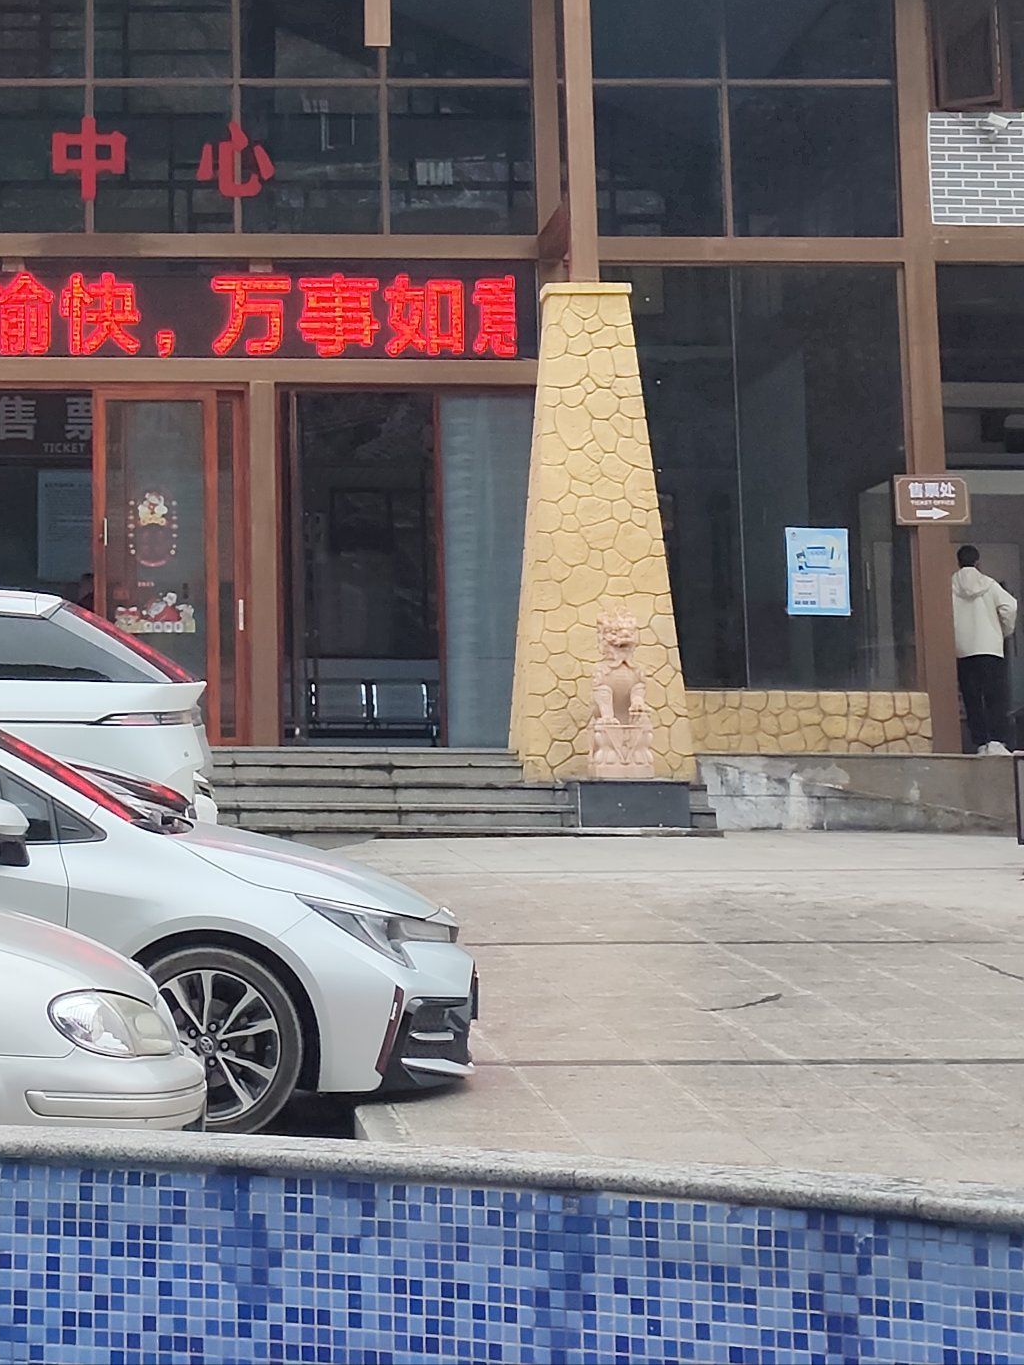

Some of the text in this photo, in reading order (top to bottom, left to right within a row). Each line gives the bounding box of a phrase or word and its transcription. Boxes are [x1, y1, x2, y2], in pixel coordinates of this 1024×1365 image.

[43, 442, 86, 454] TICKET
[908, 482, 956, 498] 售票处
